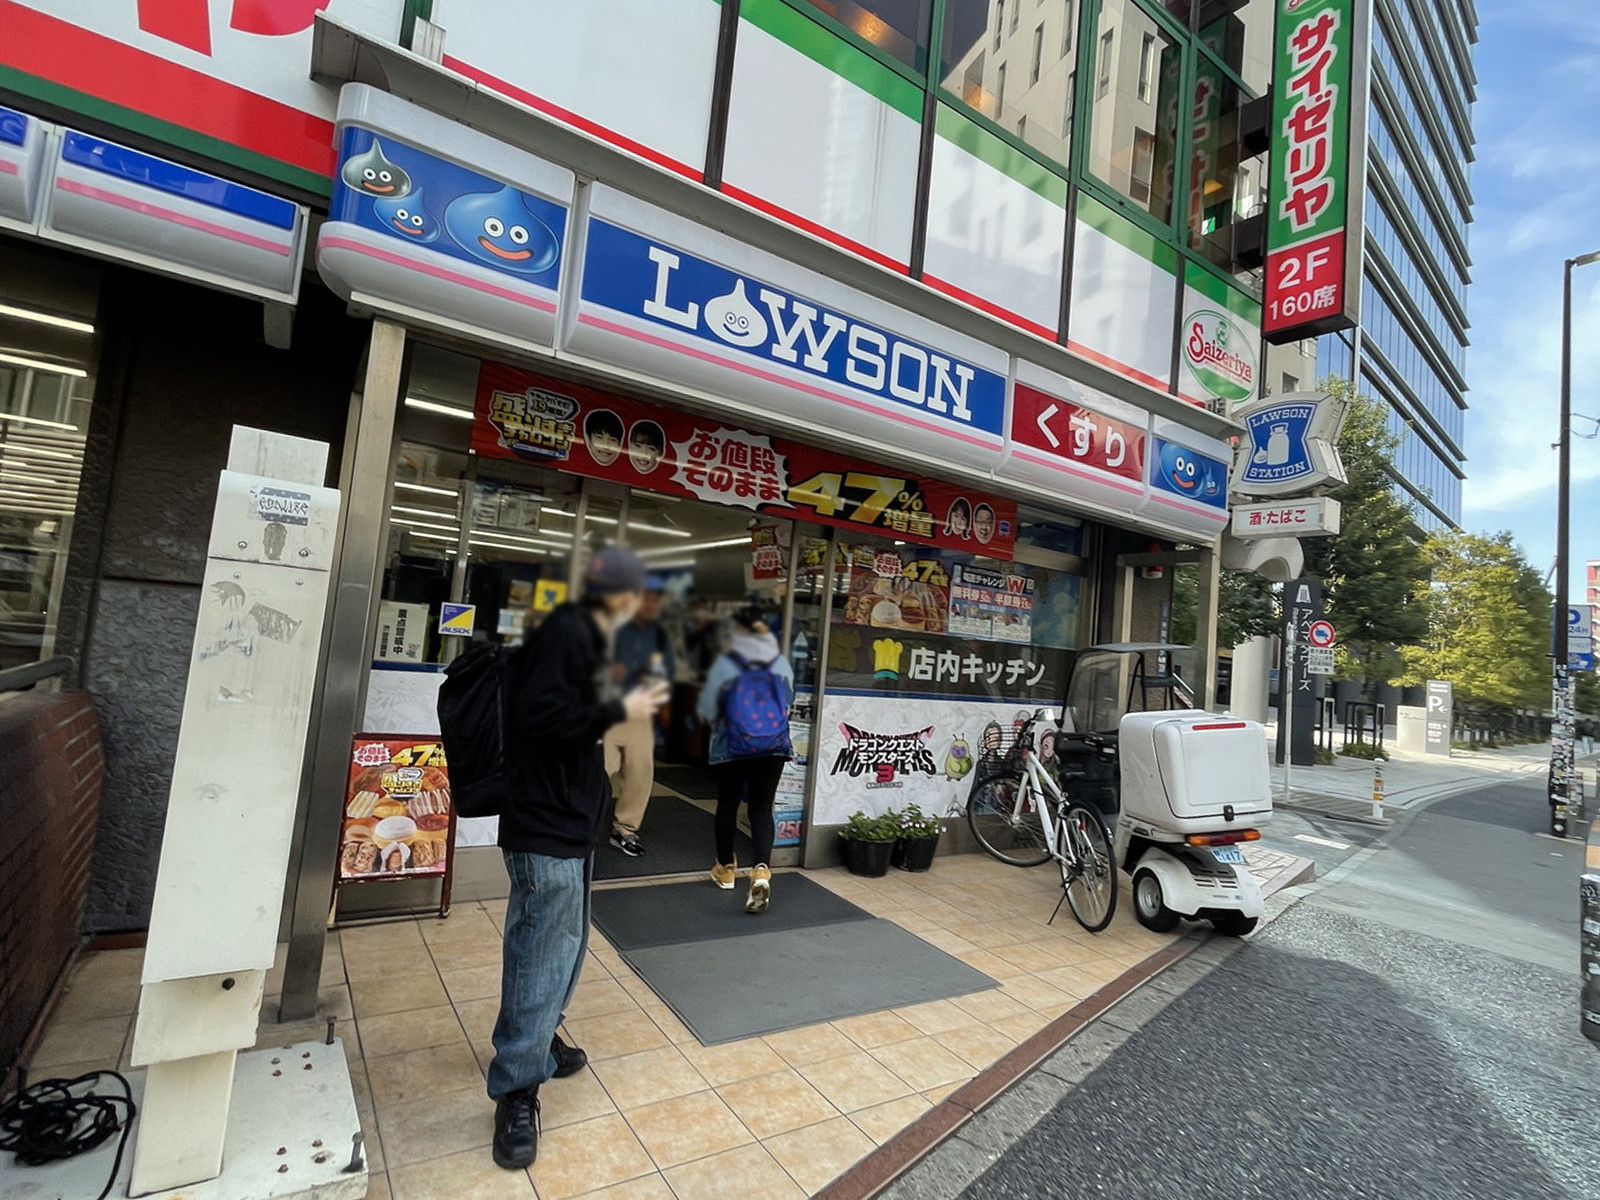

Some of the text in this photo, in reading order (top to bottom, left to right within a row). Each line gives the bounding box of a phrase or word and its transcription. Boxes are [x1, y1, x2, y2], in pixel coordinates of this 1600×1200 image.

[1284, 13, 1335, 227] サイゼリヤ
[1278, 246, 1331, 290] 2F
[1269, 284, 1338, 320] 160席
[643, 246, 975, 421] LWSON
[1187, 321, 1252, 380] Saizeriya
[1036, 403, 1126, 467] くすり
[1251, 408, 1310, 428] LAWSON
[688, 432, 779, 478] お値段
[1249, 461, 1306, 478] STATION
[682, 459, 781, 501] そのまま
[787, 471, 923, 524] 47%
[883, 507, 934, 538] 増量
[441, 626, 471, 634] ALSOK
[908, 646, 1045, 687] 店内キッチン
[1428, 695, 1443, 713] P
[876, 763, 895, 784] 3
